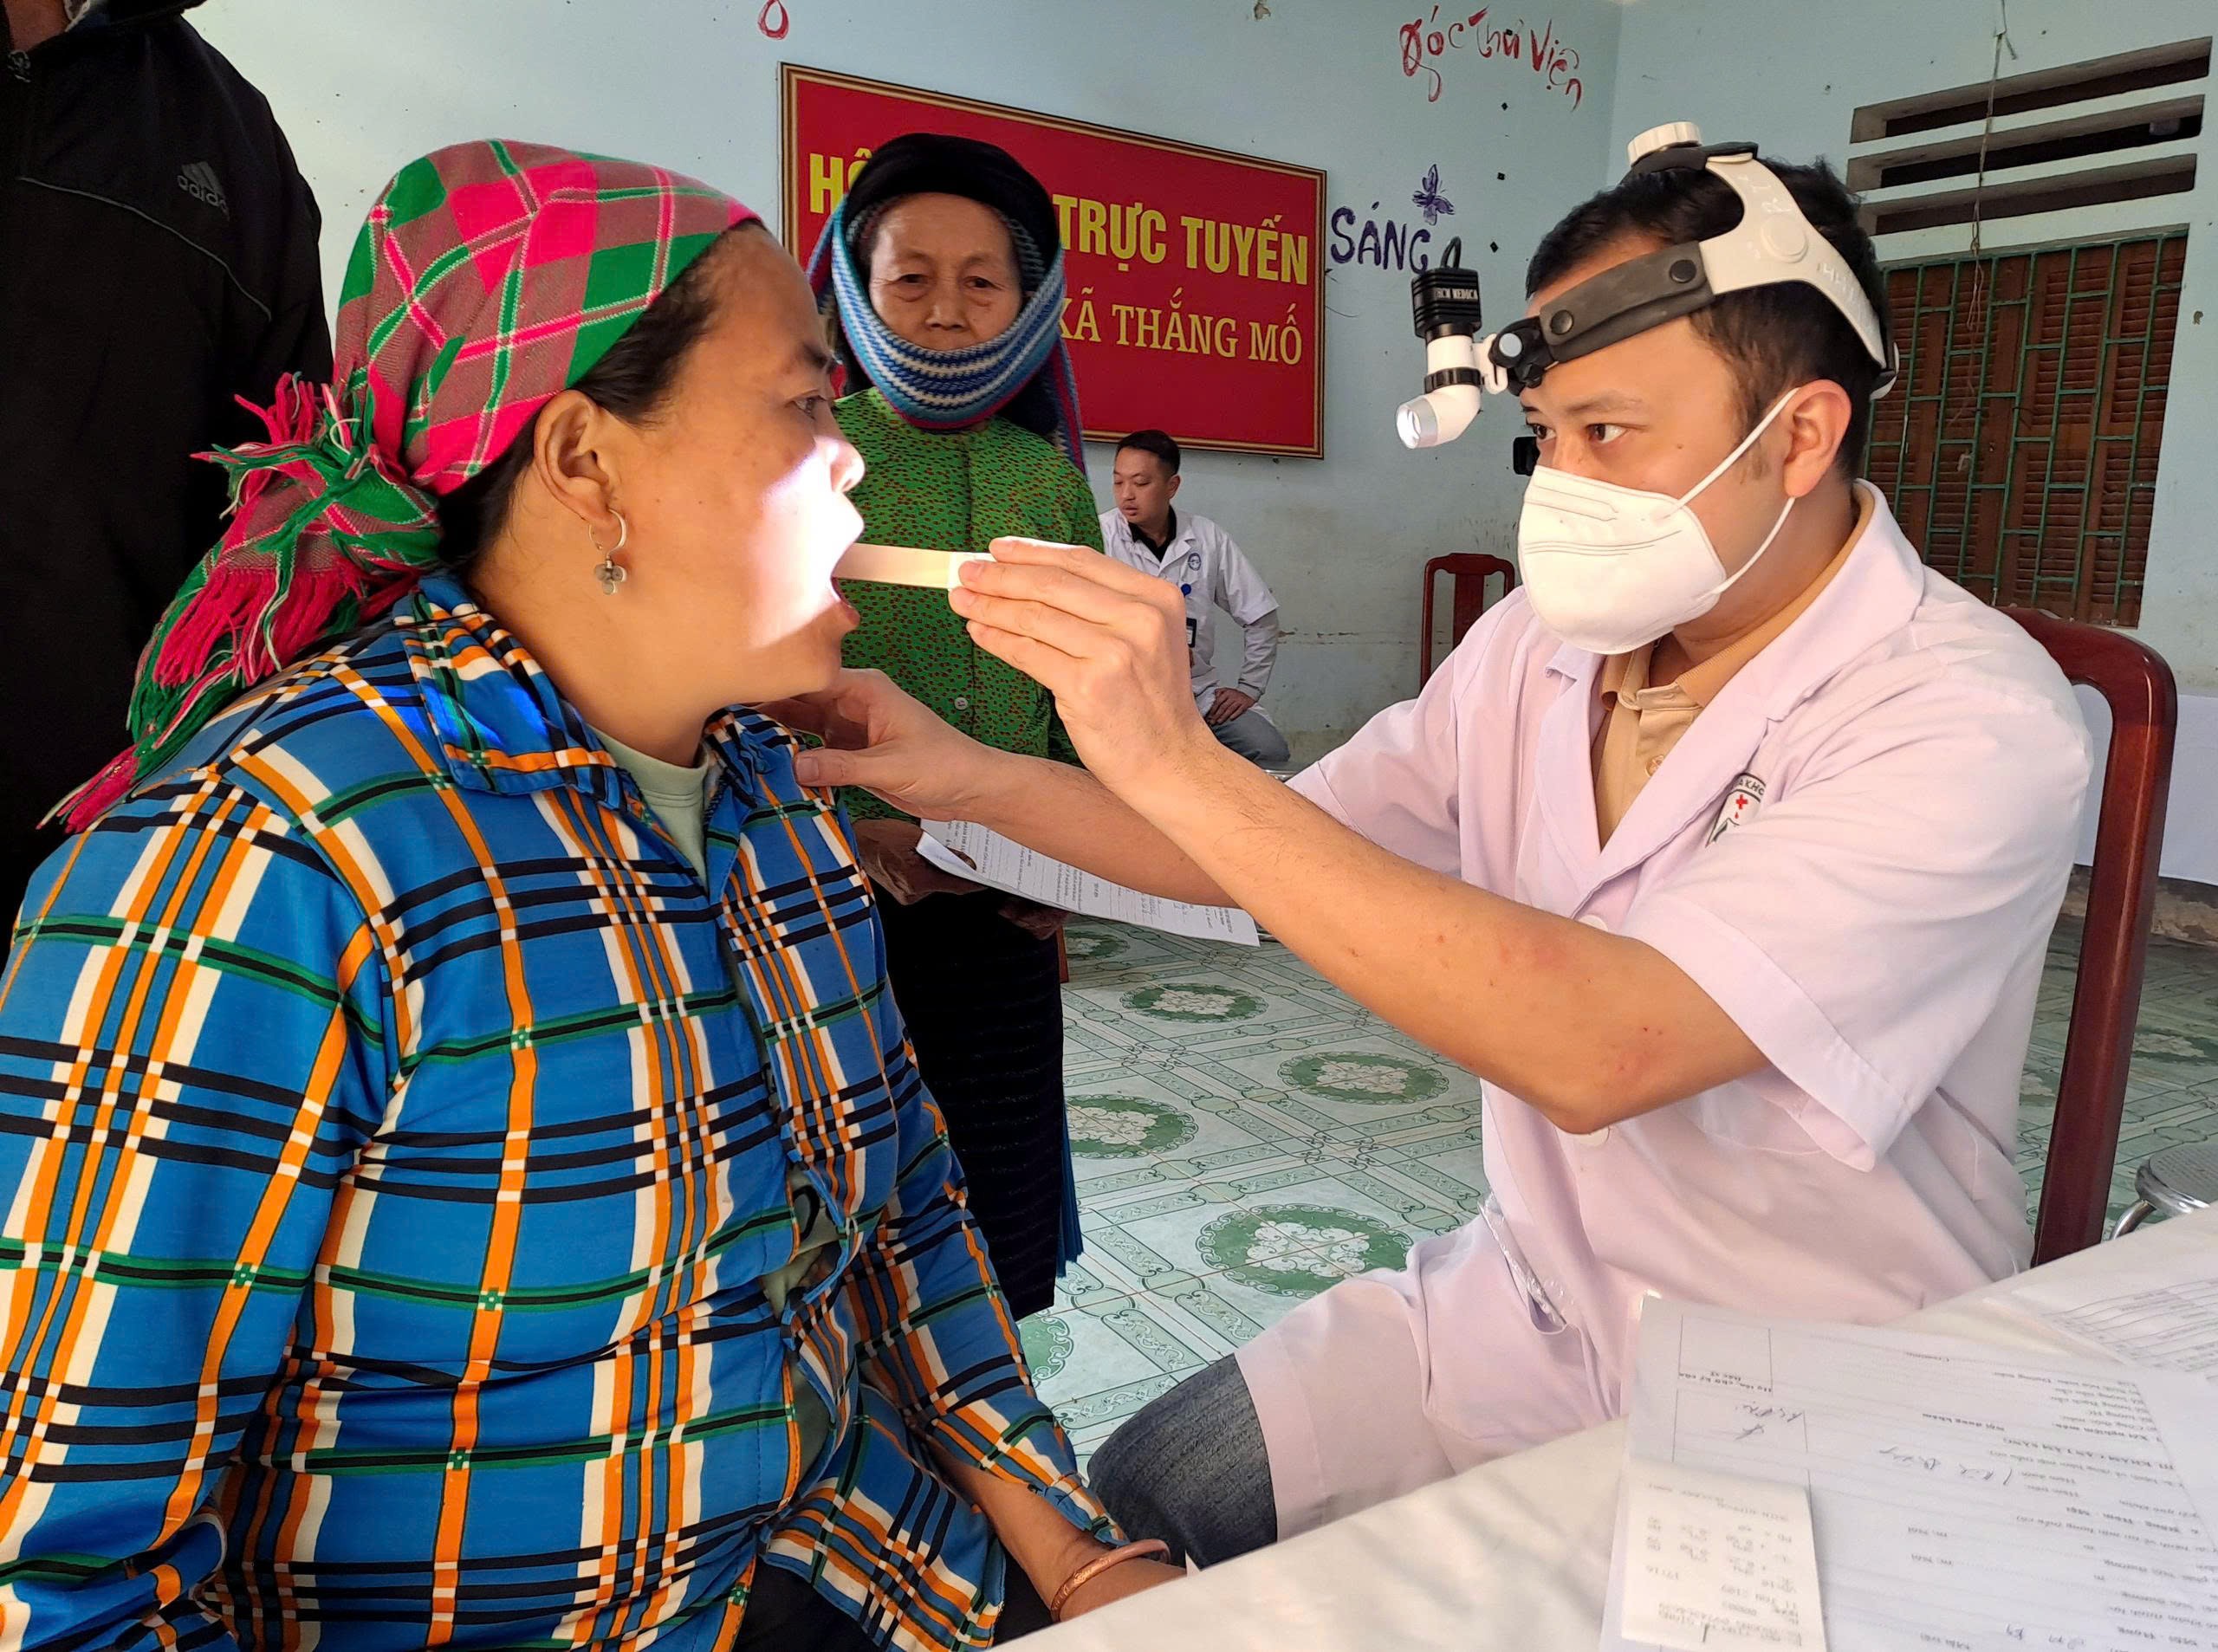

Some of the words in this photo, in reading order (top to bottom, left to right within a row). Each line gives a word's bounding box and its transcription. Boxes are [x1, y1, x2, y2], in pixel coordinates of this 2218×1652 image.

[1053, 193, 1168, 271] TRỰC
[1181, 213, 1309, 286] TUYẾN
[1330, 201, 1431, 275] SÁNG
[1112, 287, 1239, 360] THẮNG
[1248, 301, 1303, 366] MỐ
